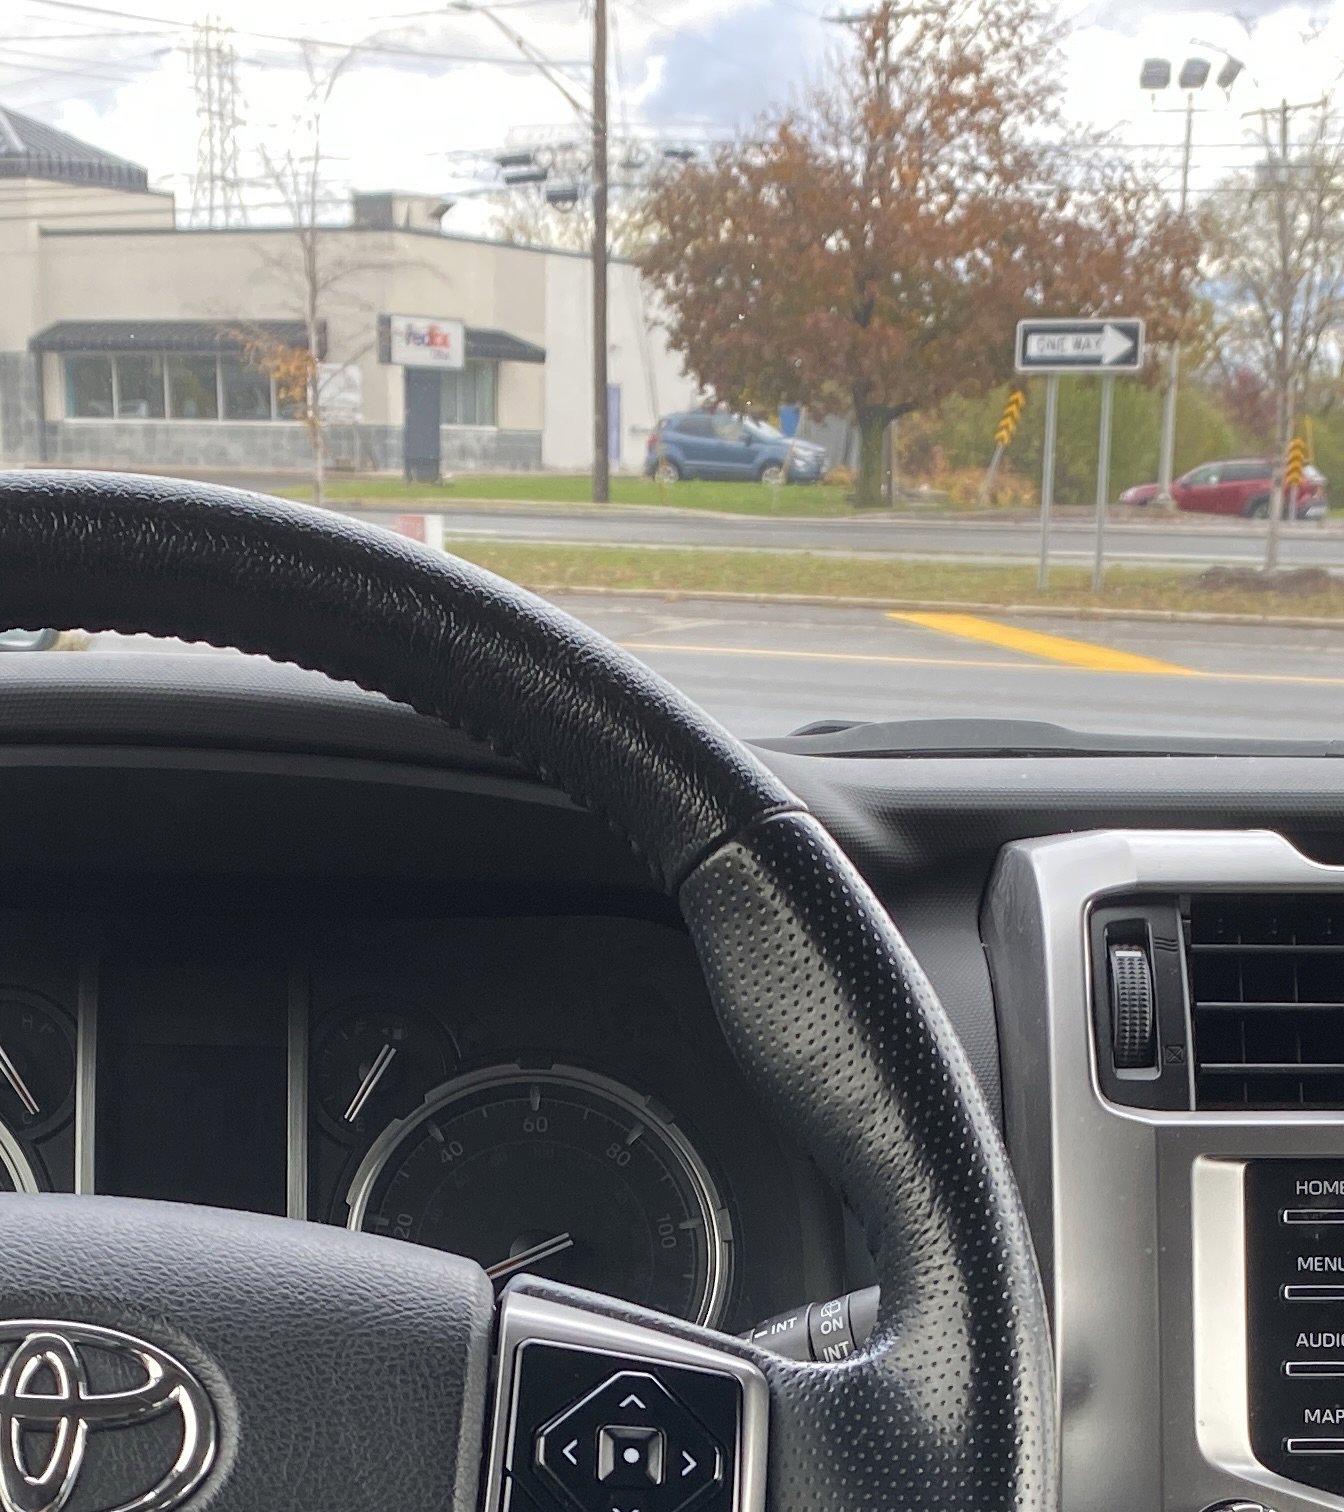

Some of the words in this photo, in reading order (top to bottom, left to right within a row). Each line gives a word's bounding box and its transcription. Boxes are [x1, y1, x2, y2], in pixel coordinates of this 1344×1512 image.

[1036, 335, 1065, 353] ONE
[1071, 335, 1103, 352] WAY
[522, 1116, 548, 1134] 60
[440, 1140, 465, 1165] 40
[606, 1141, 631, 1167] 80
[393, 1212, 414, 1240] 20
[655, 1212, 677, 1249] 100
[770, 1316, 798, 1335] INT
[820, 1316, 844, 1335] ON
[822, 1340, 850, 1363] INT
